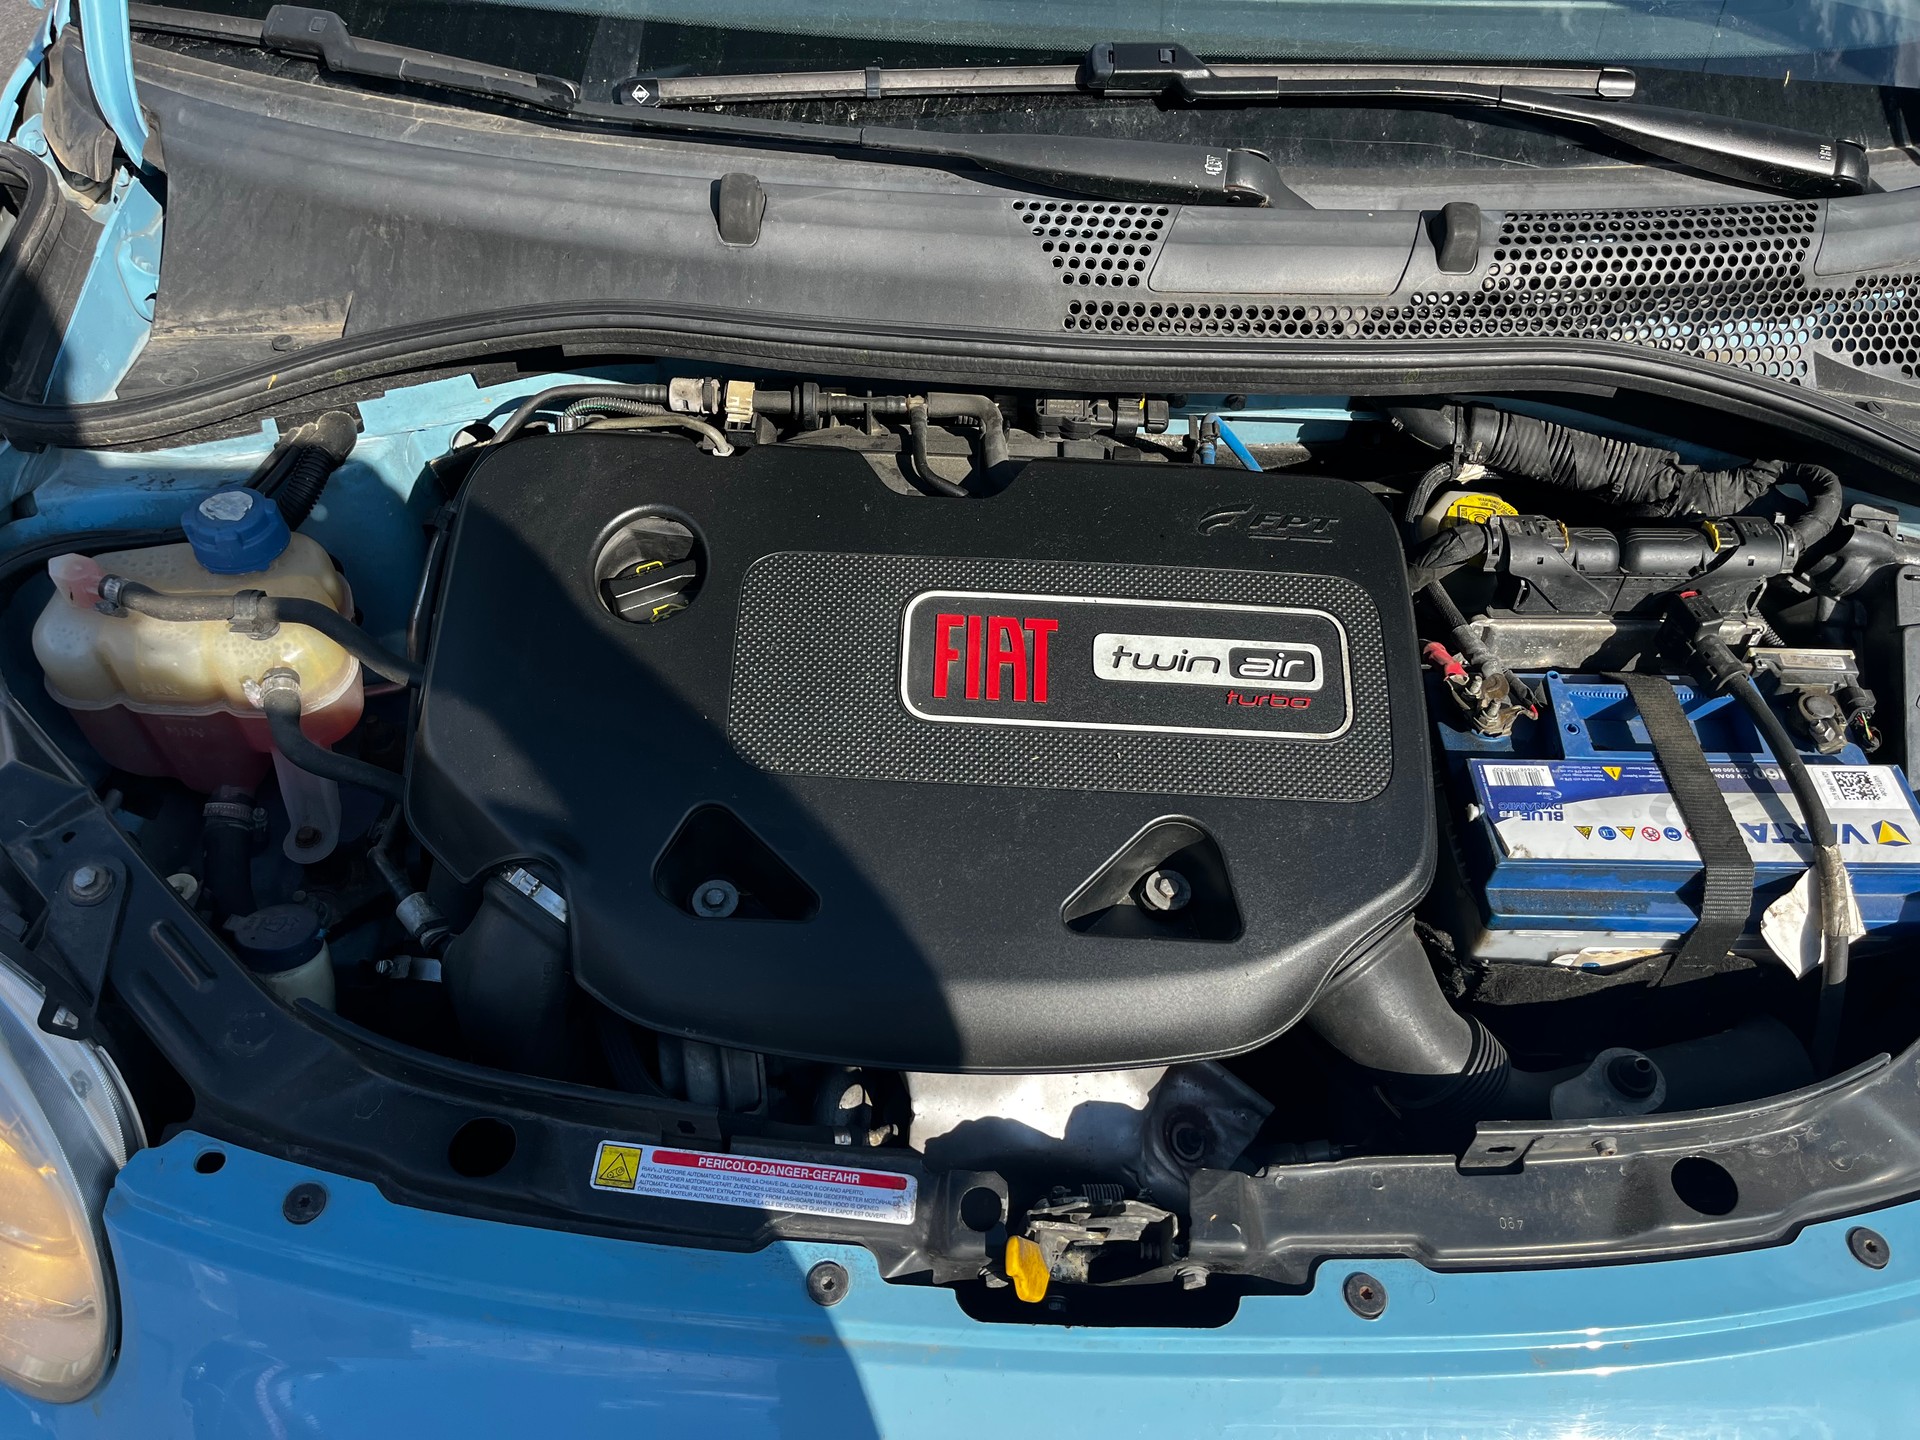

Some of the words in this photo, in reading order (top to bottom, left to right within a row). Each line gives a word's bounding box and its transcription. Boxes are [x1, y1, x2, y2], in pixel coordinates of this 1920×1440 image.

[1249, 511, 1341, 535] FPT
[933, 613, 1059, 703] FIAT
[1112, 645, 1221, 674] twin
[1237, 652, 1305, 679] air
[1226, 689, 1312, 709] turbo
[1498, 802, 1563, 810] DYNAMIC
[1521, 811, 1564, 821] BLUE
[1739, 822, 1870, 843] VRTA
[698, 1157, 860, 1184] PERICOLO-DANGER-GEFAHR
[640, 1173, 684, 1182] AUTOMATISCHER
[823, 1193, 863, 1202] GEOEFFNETER
[791, 1182, 813, 1190] QUADRO
[671, 1189, 692, 1197] MOTEUR
[784, 1202, 808, 1210] CONTACT
[809, 1205, 827, 1213] QUAND
[782, 1195, 815, 1204] DASHBOARD
